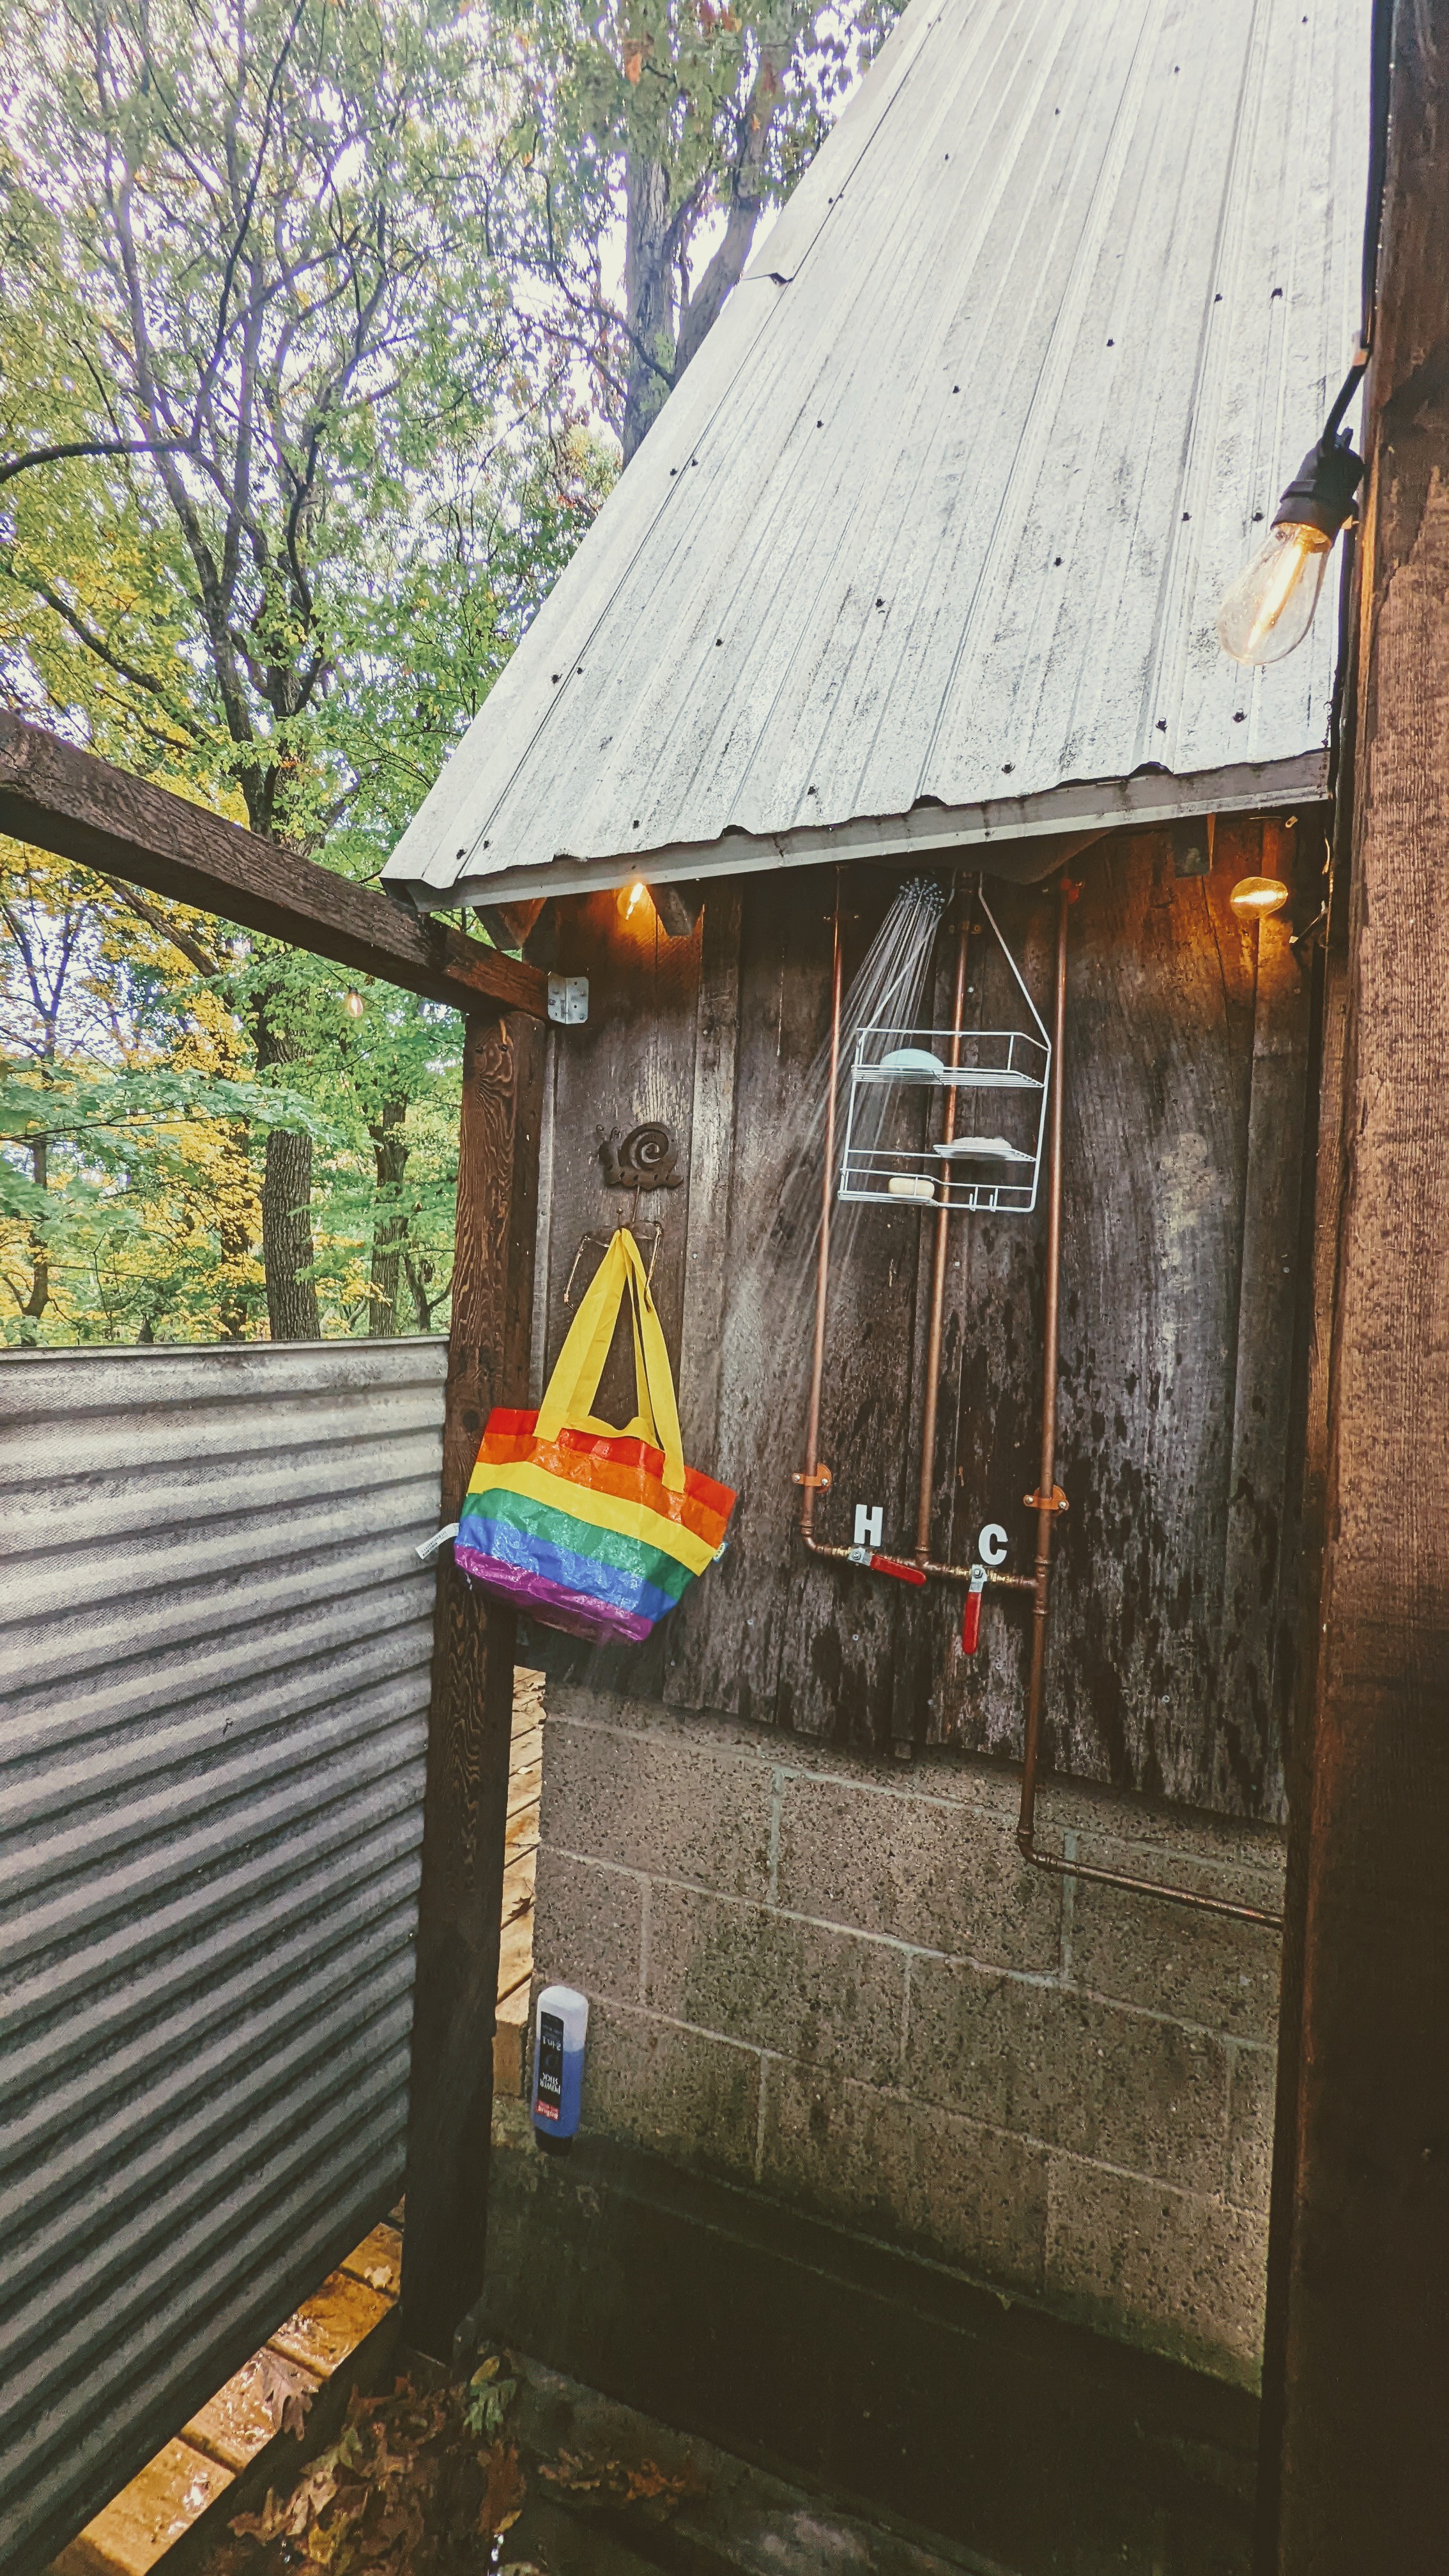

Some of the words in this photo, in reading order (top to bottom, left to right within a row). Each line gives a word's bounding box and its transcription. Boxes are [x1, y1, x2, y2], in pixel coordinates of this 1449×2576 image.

[854, 1504, 883, 1547] H
[979, 1523, 1008, 1565] C
[539, 2078, 561, 2095] POWER
[542, 2072, 558, 2085] STICK
